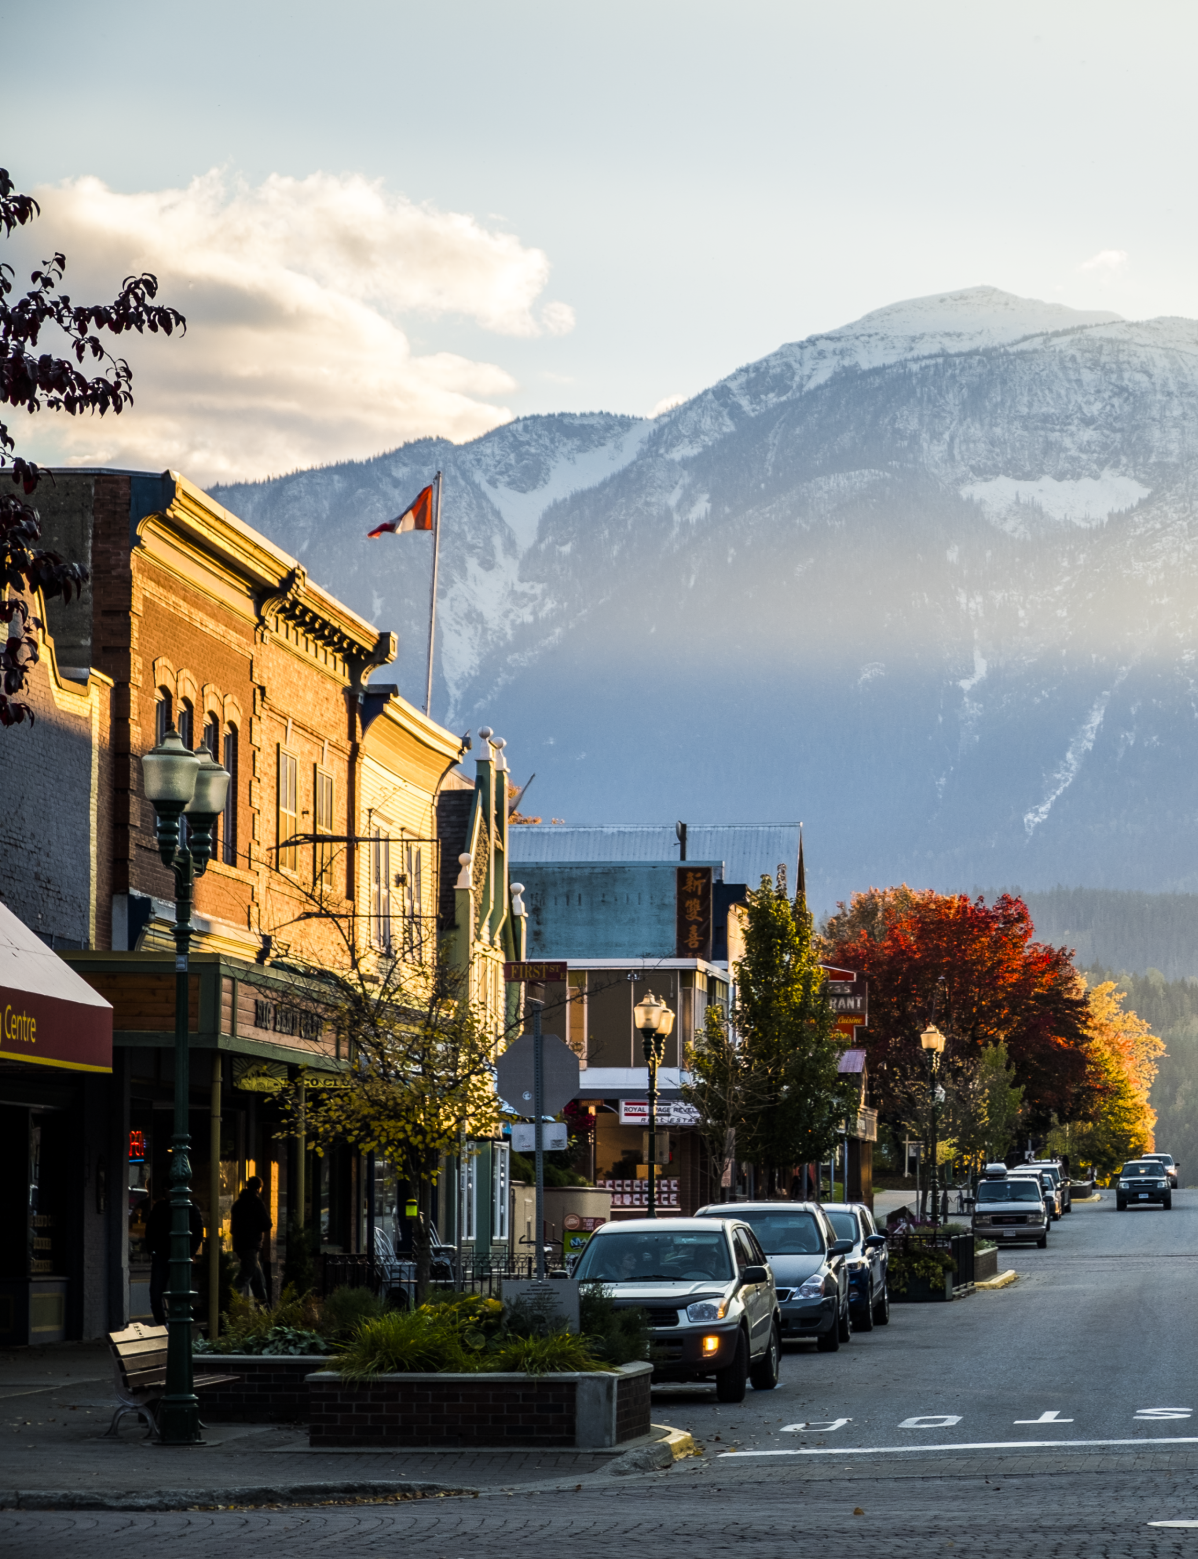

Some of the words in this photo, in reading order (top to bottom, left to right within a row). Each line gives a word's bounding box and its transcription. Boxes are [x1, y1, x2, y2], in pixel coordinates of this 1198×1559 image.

[682, 871, 706, 949] 新雙喜
[511, 964, 548, 979] FIRST
[549, 965, 561, 973] ST
[5, 1004, 36, 1043] Centre
[254, 999, 271, 1030] BIG
[838, 1016, 863, 1024] Cuisine
[780, 1407, 1193, 1433] STOP
